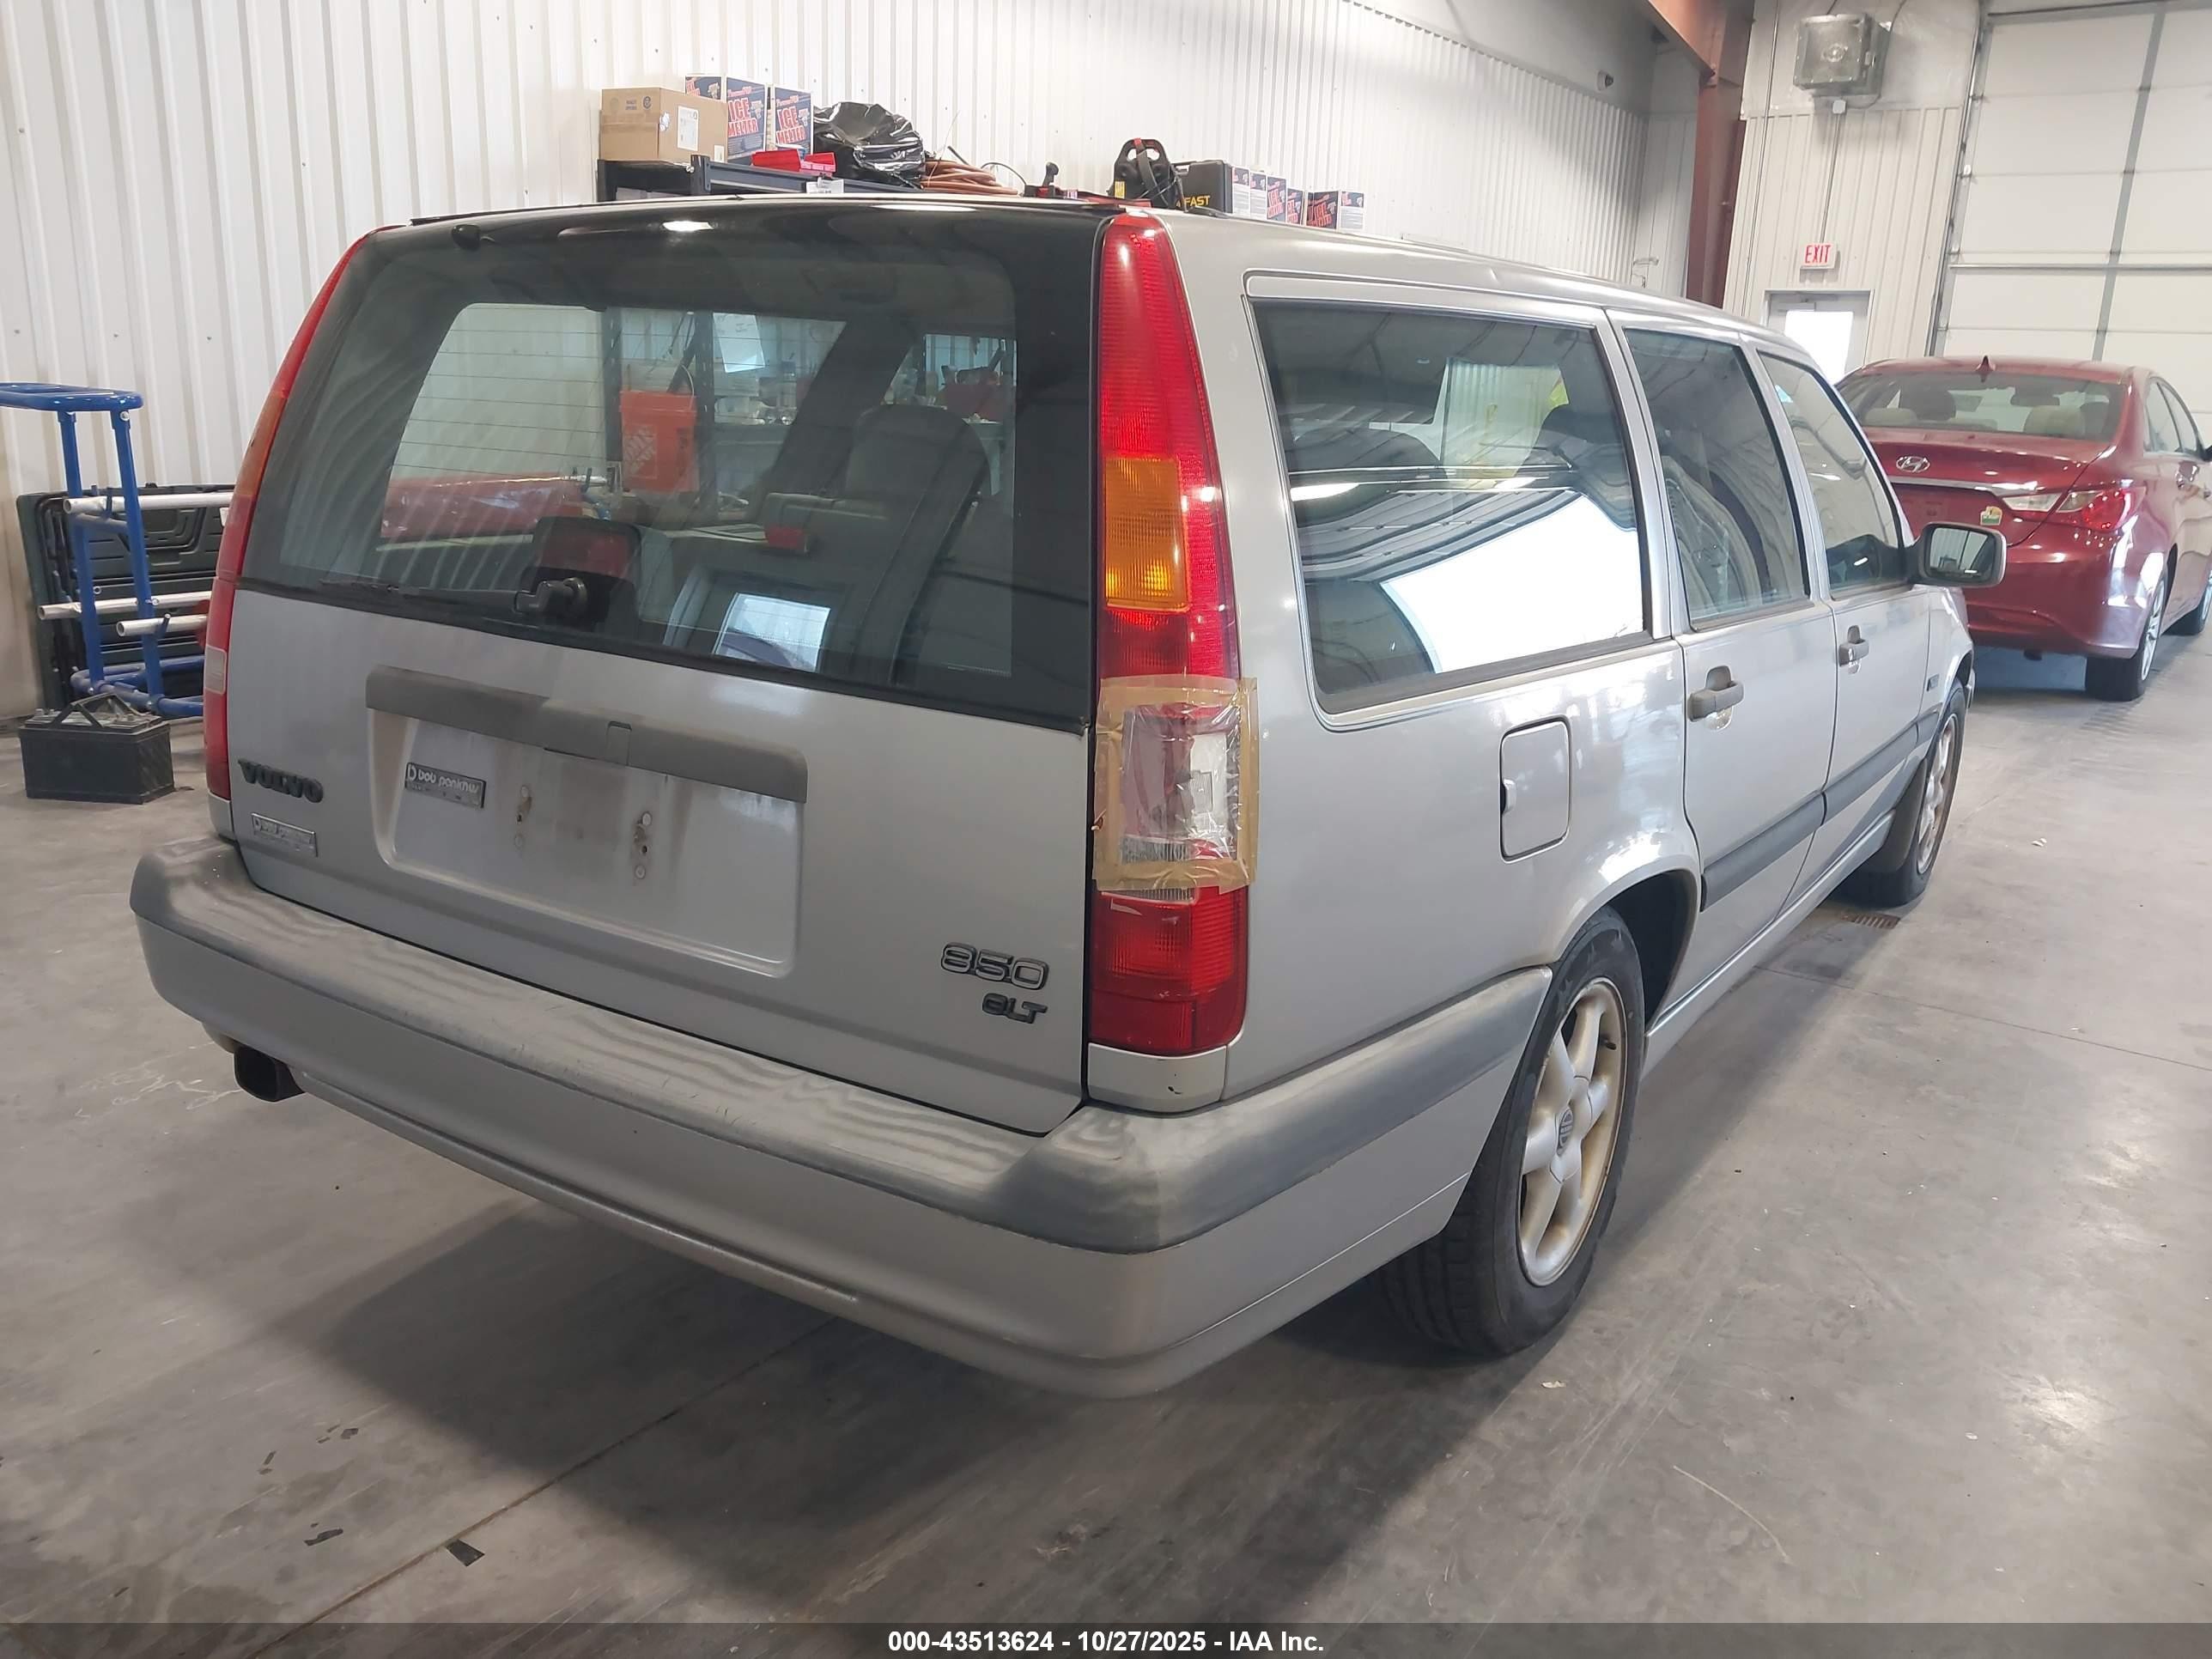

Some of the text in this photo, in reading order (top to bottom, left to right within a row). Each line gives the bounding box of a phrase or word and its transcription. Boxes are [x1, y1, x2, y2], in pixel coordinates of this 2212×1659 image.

[728, 97, 751, 122] ICE
[777, 106, 799, 131] ICE
[728, 118, 759, 137] MELTER
[776, 125, 806, 144] MELTER
[1804, 244, 1832, 264] EXIT
[238, 758, 324, 803] VOLVO
[941, 941, 1049, 990] 850
[982, 993, 1048, 1024] GLT
